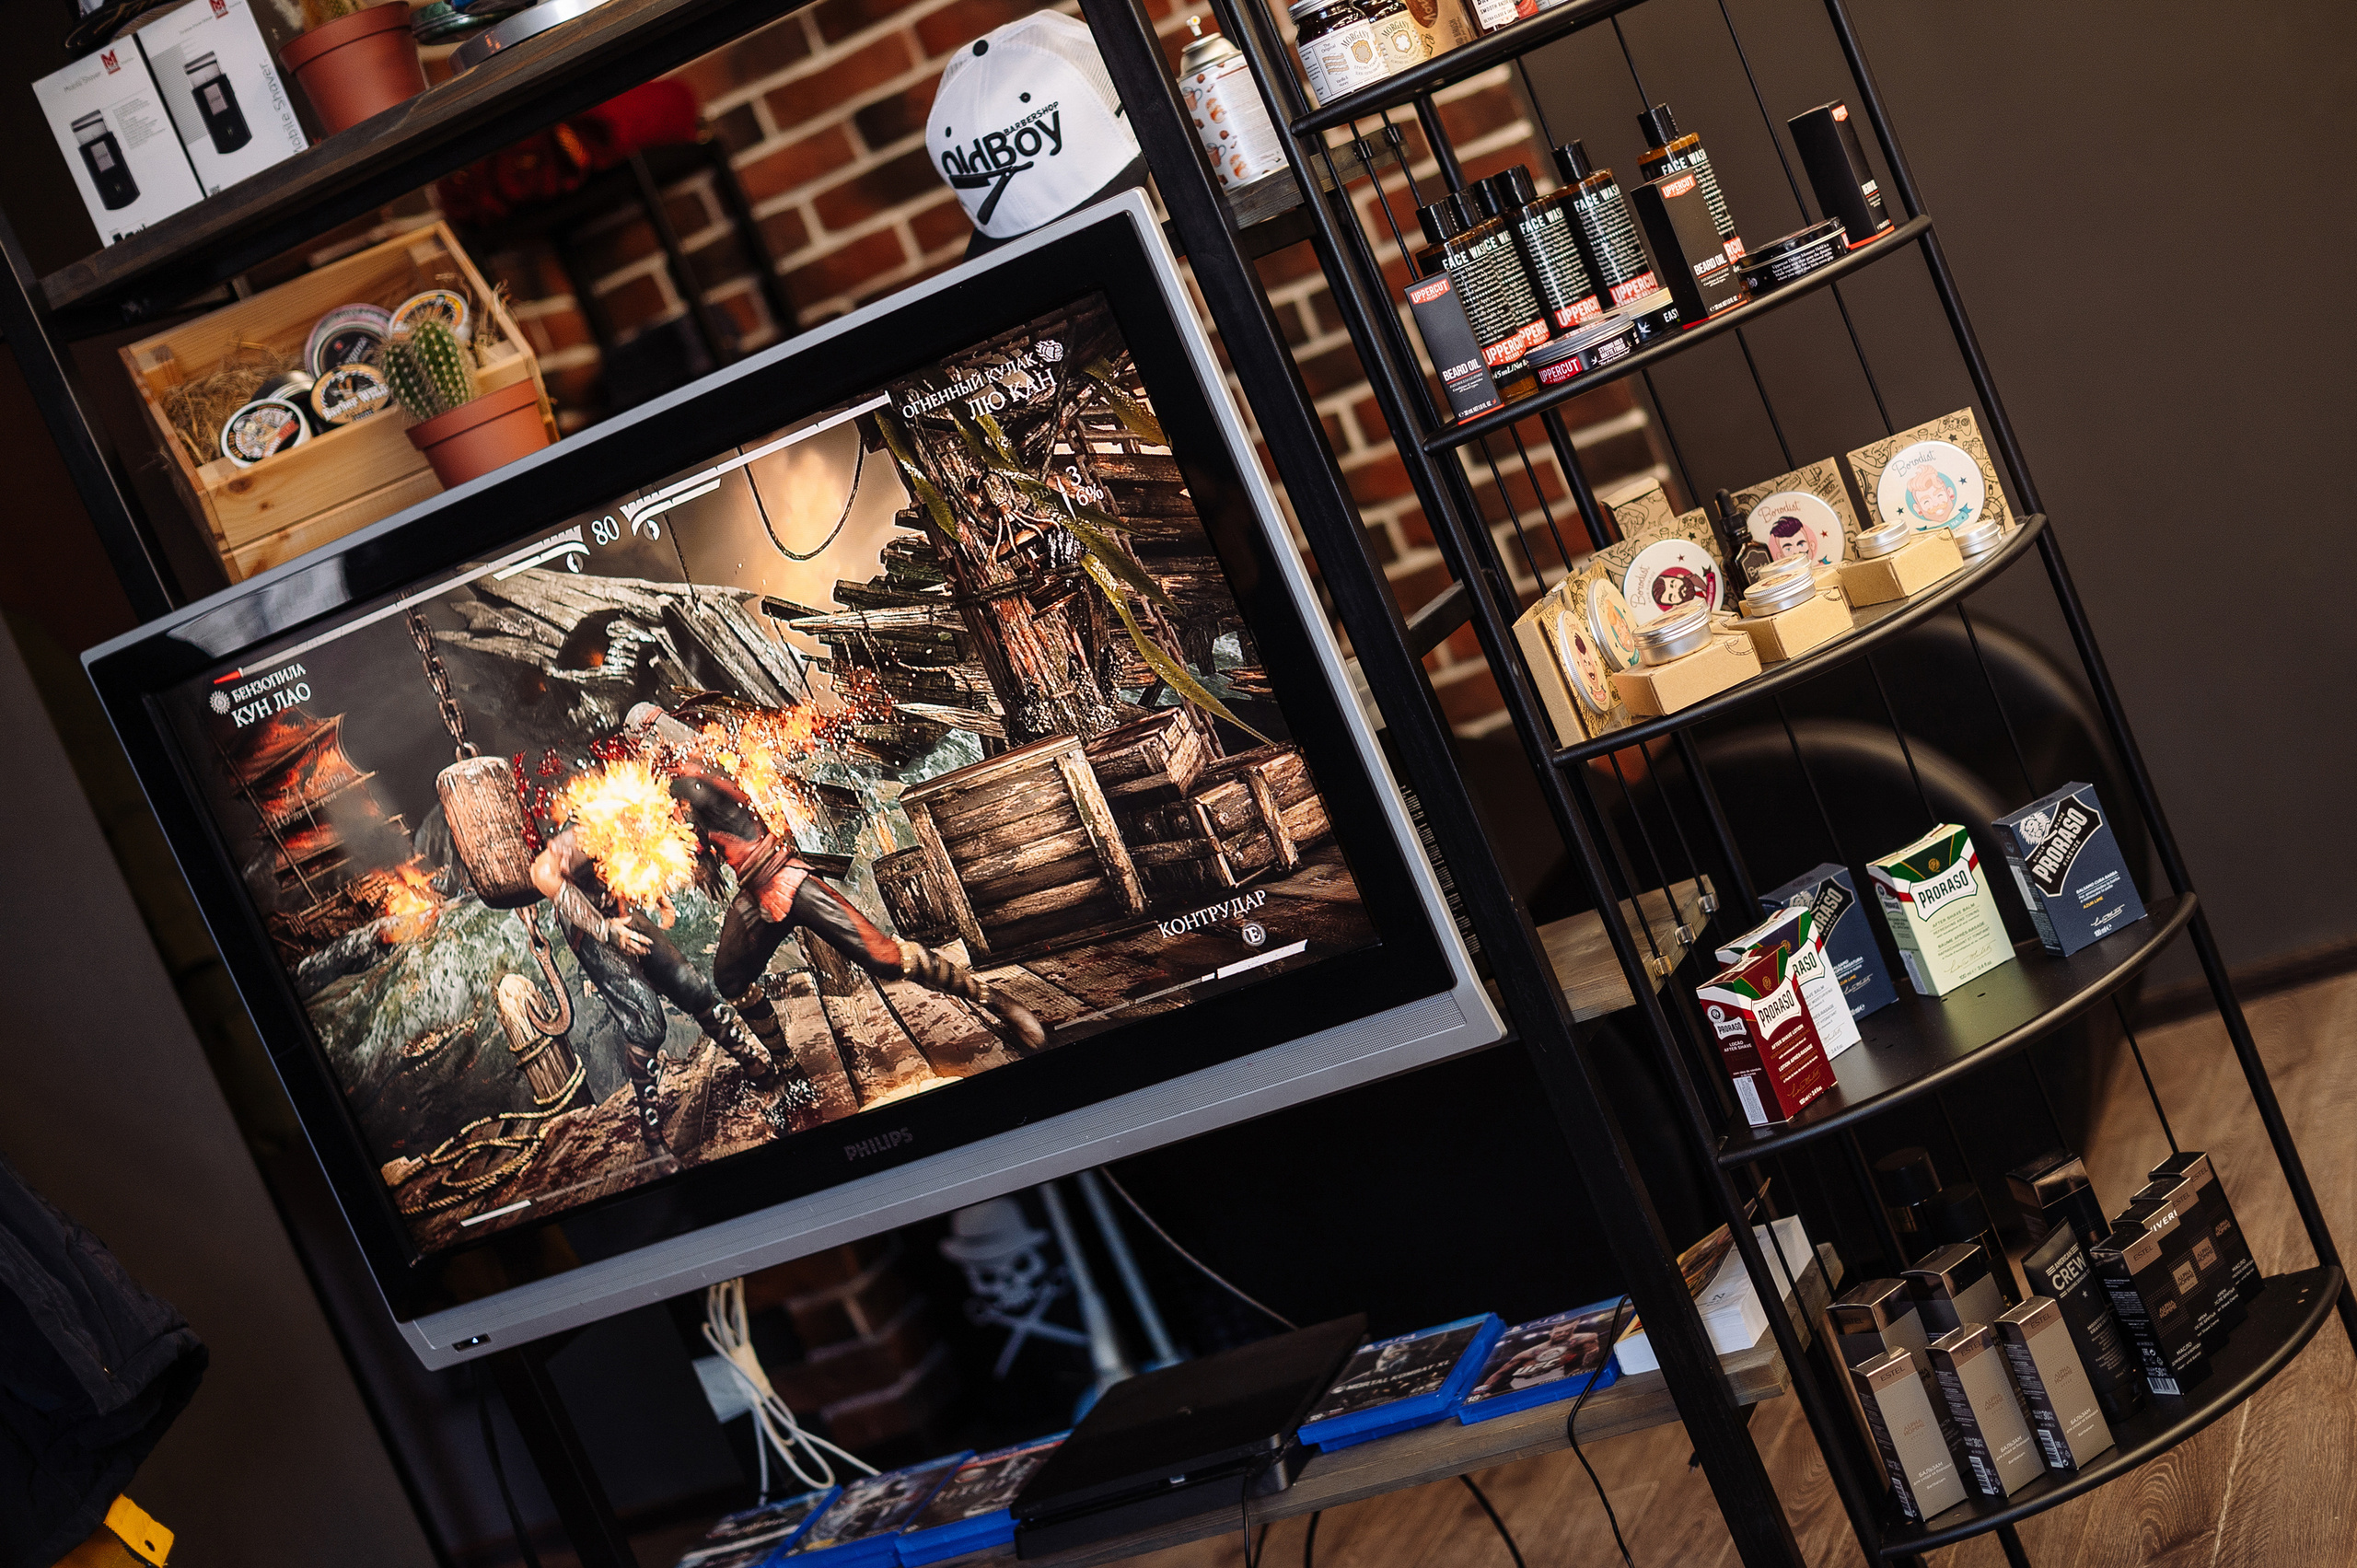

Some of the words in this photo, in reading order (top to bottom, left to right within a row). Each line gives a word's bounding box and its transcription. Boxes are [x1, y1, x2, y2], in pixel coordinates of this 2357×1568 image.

[1480, 5, 1498, 15] SMOOTH
[1004, 101, 1059, 135] BARBERSHOP
[1661, 157, 1688, 176] FACE
[1663, 176, 1696, 198] UPPERCUT
[1573, 192, 1600, 213] FACE
[1518, 215, 1546, 235] FACE
[1497, 229, 1512, 245] WAS
[1442, 250, 1469, 270] FACE
[1469, 242, 1485, 260] WAS
[1693, 257, 1717, 275] BEARD
[1715, 253, 1727, 268] OIL
[1411, 280, 1449, 304] UPPERCUT
[1504, 352, 1520, 362] DELUXE
[1598, 342, 1613, 354] STRONG
[1442, 362, 1469, 381] BEARD
[1468, 358, 1481, 373] OIL
[1538, 358, 1580, 384] UPPERCUT
[902, 372, 984, 419] ОГНЕННЫЙ
[985, 352, 1039, 384] КУЛАК
[968, 390, 1006, 421] ЛЮ
[1007, 367, 1058, 403] КАН
[1892, 450, 1936, 477] Borodist
[1065, 465, 1082, 487] 3
[1075, 484, 1104, 506] 6%
[1758, 501, 1802, 524] Borodist
[591, 516, 621, 546] 80
[1950, 518, 1959, 528] TEA
[1630, 564, 1650, 609] Borodist
[231, 663, 307, 703] БЕНЗОПИЛА
[231, 697, 273, 728] КУН
[273, 681, 312, 712] ЛАО
[2032, 846, 2045, 863] SINGLE
[2054, 812, 2065, 829] BLADE
[2032, 807, 2087, 884] PRORASO
[2063, 840, 2081, 866] FIRENZE
[1918, 870, 1968, 909] PRORASO
[2076, 881, 2095, 894] BALSAMO
[2094, 896, 2104, 904] LIME
[1157, 889, 1267, 939] КОНТРУДАР
[1933, 918, 1946, 928] AFTER
[1946, 910, 1962, 920] SHAVE
[1962, 902, 1975, 912] BALM
[1792, 951, 1817, 978] RASO
[1758, 989, 1795, 1028] PRORASO
[1717, 1024, 1744, 1035] PRORASO
[1771, 1039, 1782, 1051] AFTER
[843, 1126, 913, 1161] PHILIPS
[2191, 1167, 2208, 1183] ESTEL
[2173, 1191, 2190, 1208] ESTEL
[2149, 1209, 2178, 1233] IVERI
[2214, 1219, 2229, 1231] ALPHA
[2215, 1225, 2232, 1237] HOMME
[2054, 1252, 2073, 1271] AMERICAN
[2133, 1245, 2154, 1261] ESTEL
[2197, 1245, 2212, 1259] ALPHA
[2198, 1249, 2214, 1263] HOMME
[2052, 1251, 2087, 1291] CREW
[2177, 1269, 2191, 1282] ALPHA
[2178, 1273, 2194, 1288] HOMME
[2159, 1300, 2175, 1314] ALPHA
[2159, 1305, 2177, 1319] HOMME
[2030, 1313, 2051, 1330] ESTEL
[1961, 1341, 1982, 1357] ESTEL
[2177, 1342, 2192, 1355] МАСЛО
[1346, 1376, 1386, 1391] MORTAL
[1390, 1365, 1437, 1383] KOMBAT
[1437, 1359, 1452, 1370] XL
[1512, 1357, 1562, 1377] UFC
[1880, 1365, 1905, 1382] ESTEL
[2070, 1408, 2091, 1425] БАЛЬЗАМ
[2000, 1435, 2023, 1453] БАЛЬЗАМ
[1918, 1461, 1944, 1478] БАЛЬЗАМ
